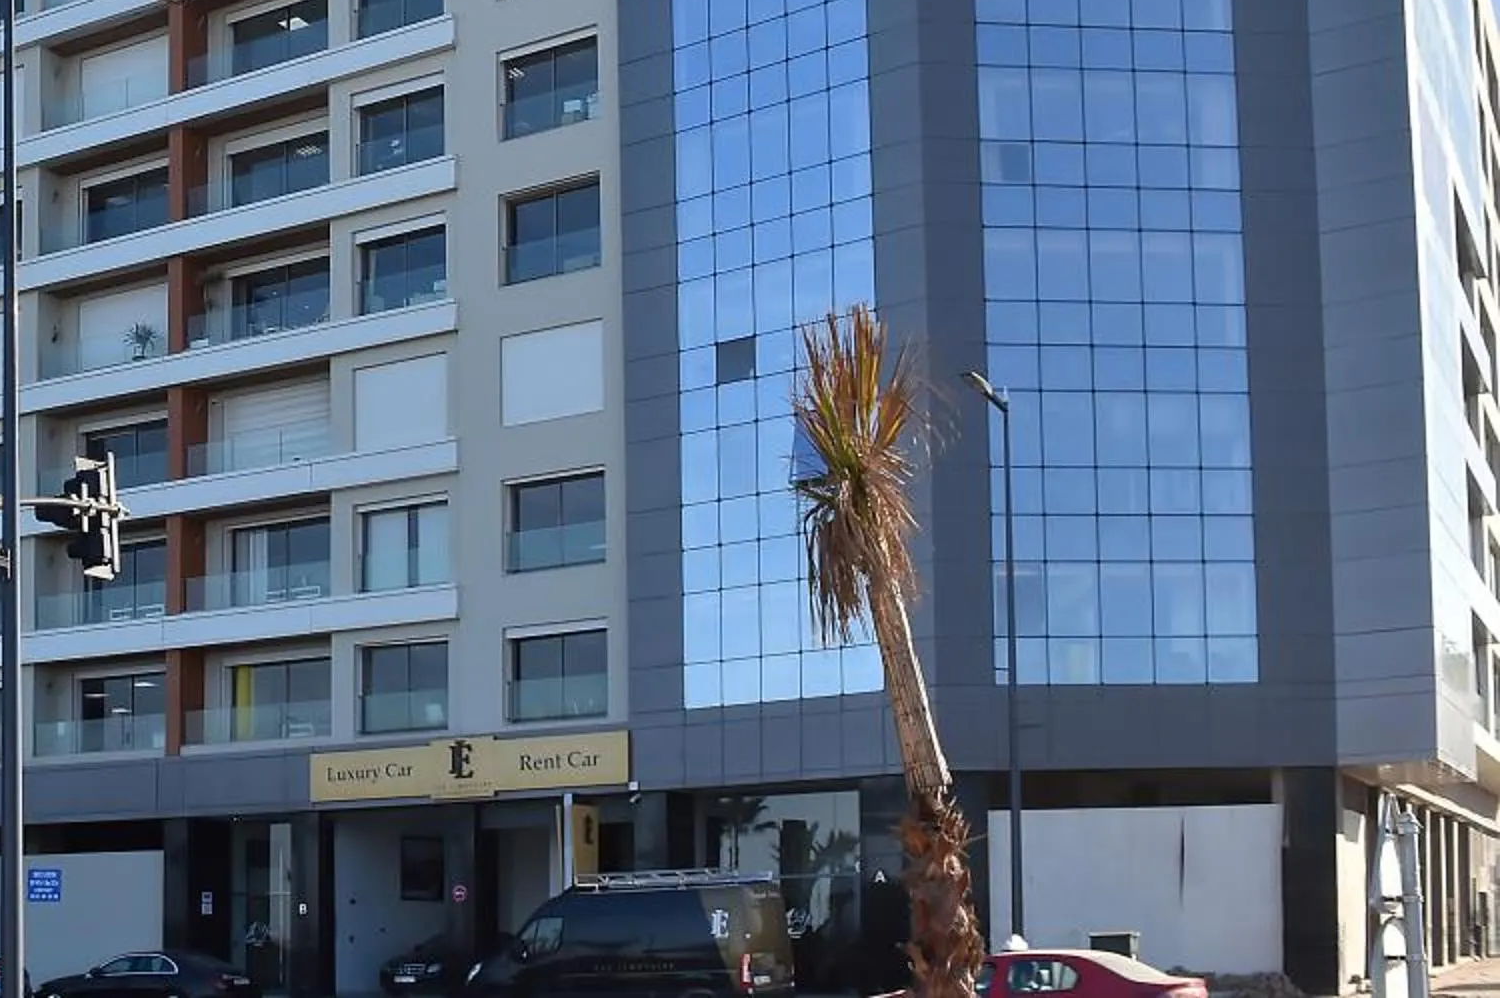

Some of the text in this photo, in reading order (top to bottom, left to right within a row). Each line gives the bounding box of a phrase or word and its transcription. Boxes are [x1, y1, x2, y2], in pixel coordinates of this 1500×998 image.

[520, 751, 600, 771] Rent Car
[326, 763, 414, 785] Luxury Car
[874, 870, 886, 883] A
[299, 903, 307, 915] B
